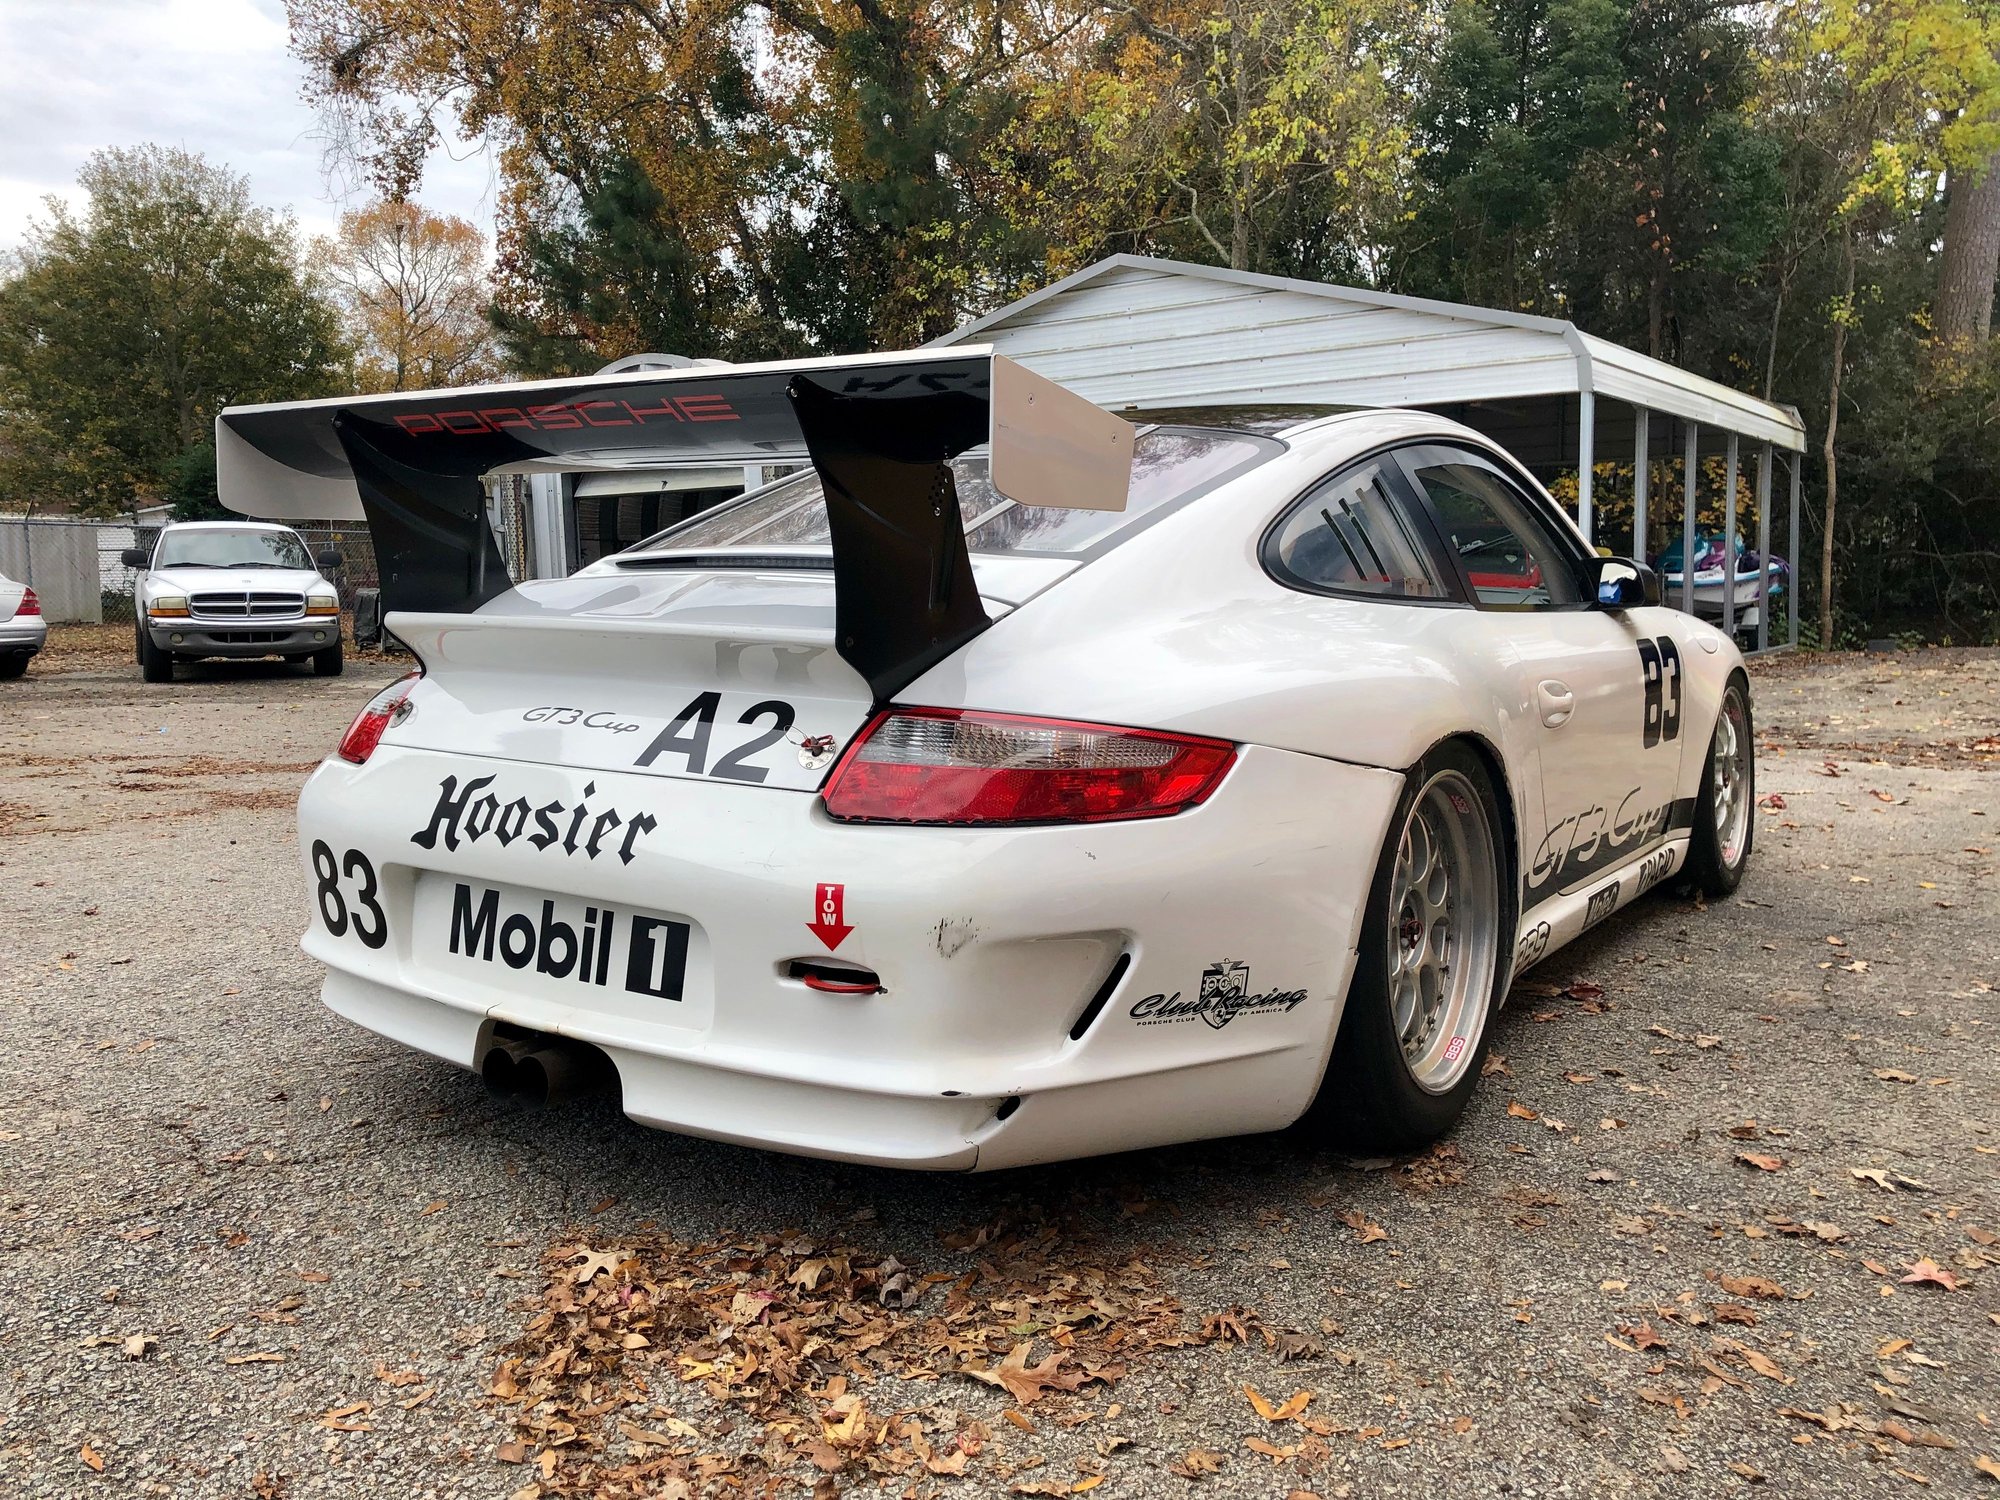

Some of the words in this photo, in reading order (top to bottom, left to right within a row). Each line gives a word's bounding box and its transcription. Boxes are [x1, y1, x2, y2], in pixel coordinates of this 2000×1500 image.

[394, 394, 741, 437] PORSCHE
[522, 706, 581, 725] GT3
[583, 709, 640, 734] Cup
[1636, 635, 1682, 750] 83
[633, 691, 796, 783] A2
[410, 773, 658, 866] Hoosier
[312, 839, 387, 949] 83
[821, 886, 837, 926] TOW
[448, 883, 615, 986] Mobil
[1129, 988, 1216, 1019] Club
[1211, 986, 1308, 1013] Racing
[1443, 1036, 1466, 1061] BBS
